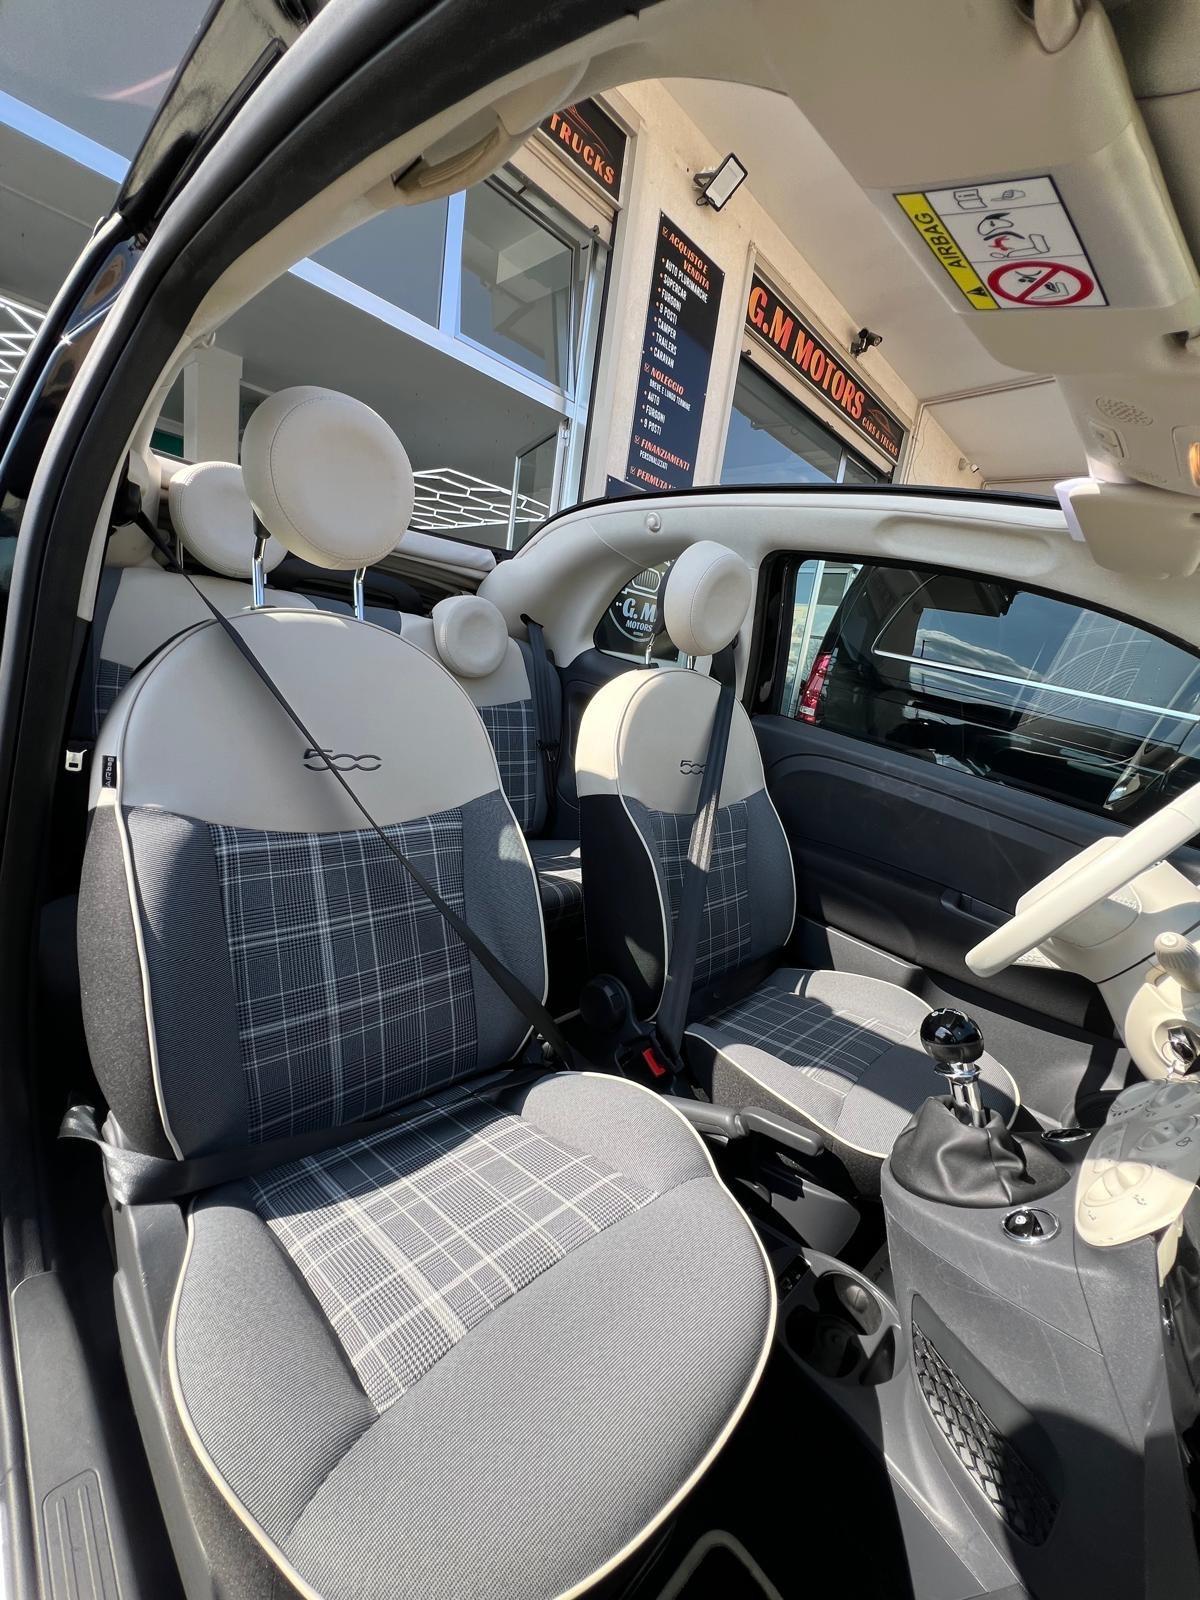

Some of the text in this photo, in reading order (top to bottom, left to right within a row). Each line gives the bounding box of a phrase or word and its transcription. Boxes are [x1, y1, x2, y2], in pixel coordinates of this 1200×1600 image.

[550, 113, 615, 185] TRUCKS
[914, 212, 967, 269] AIRBAG
[669, 233, 709, 274] ACQUISTO E
[665, 259, 679, 277] AUTO
[683, 260, 710, 290] VENDITA
[663, 306, 678, 325] POSTI
[657, 318, 677, 340] CAMPER
[656, 332, 678, 356] TRAILERS
[749, 287, 865, 420] G.M MOTORS
[653, 347, 675, 369] CARAVAN
[650, 367, 684, 395] NOLEGGIO
[647, 391, 660, 406] AUTO
[648, 420, 662, 436] POSTI
[862, 416, 876, 436] CARS
[640, 439, 690, 471] FINANZIAMENTI
[636, 469, 668, 489] PERMUTA
[625, 620, 653, 632] MOTORS
[304, 747, 382, 772] 500
